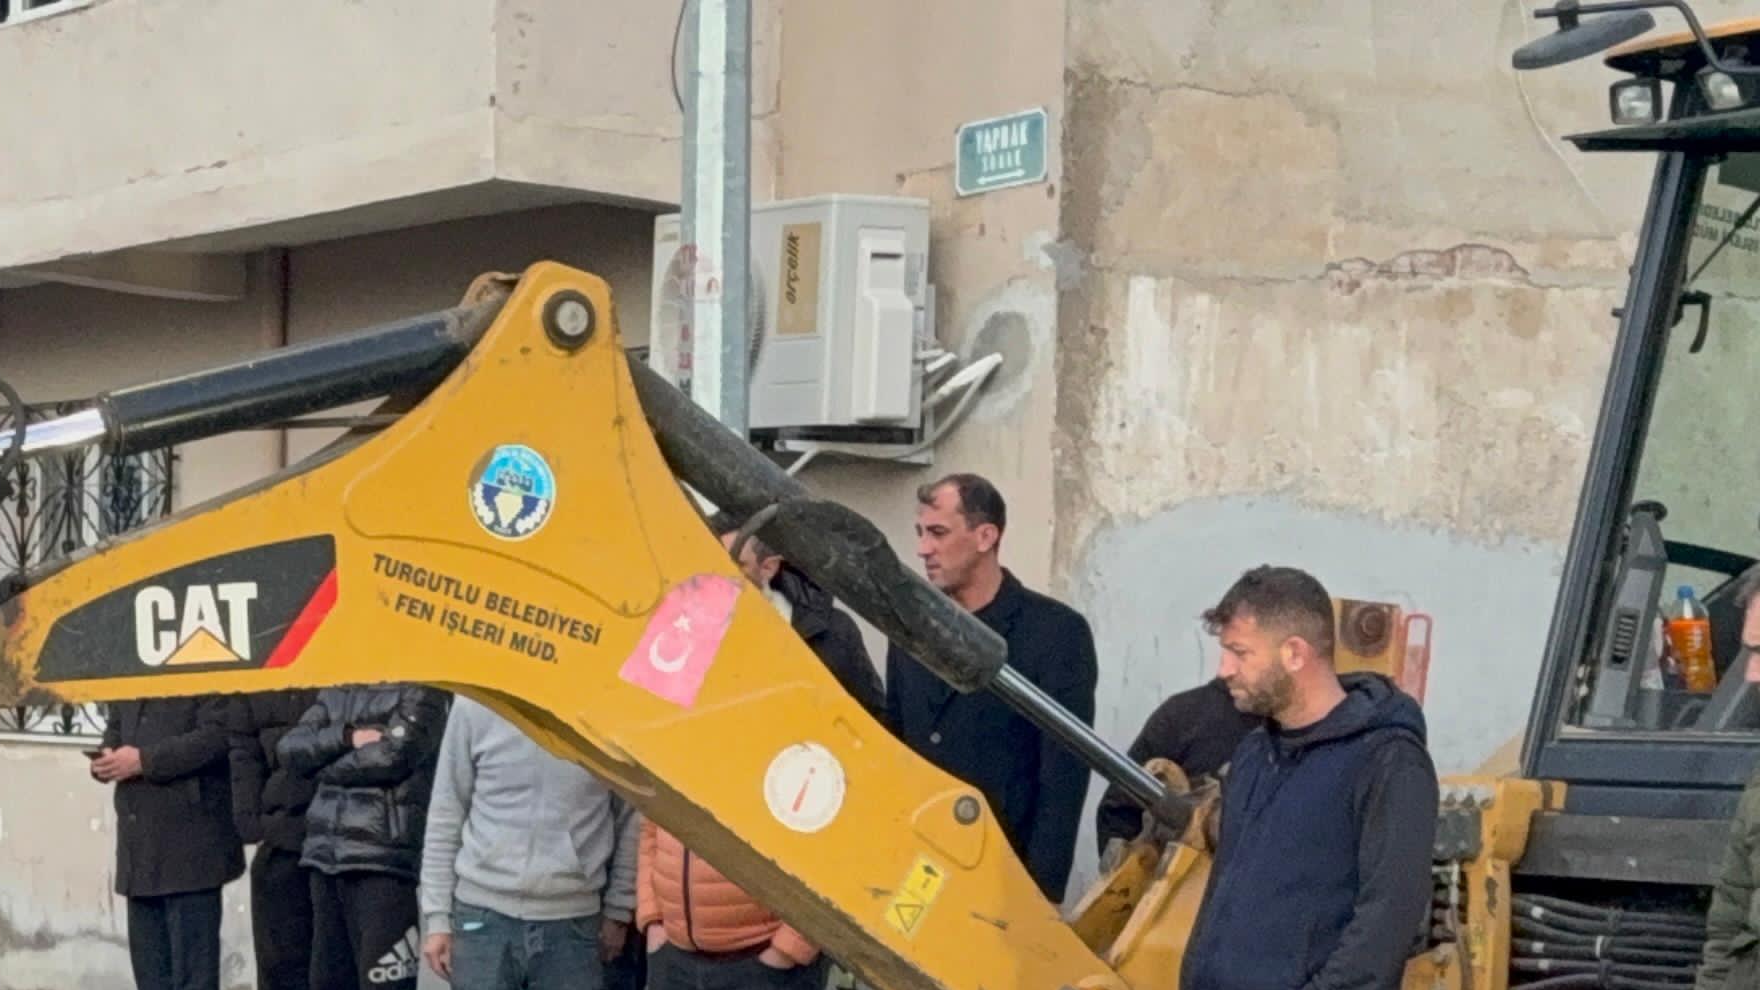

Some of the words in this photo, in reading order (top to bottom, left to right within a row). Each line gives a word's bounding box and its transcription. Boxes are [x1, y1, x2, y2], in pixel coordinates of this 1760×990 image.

[135, 581, 258, 667] CAT
[373, 553, 480, 605] TURGUTLU
[484, 591, 603, 646] BELEDİYESİ
[394, 593, 434, 622] FEN
[440, 602, 506, 646] İŞLERİ
[509, 631, 559, 664] MÜD.
